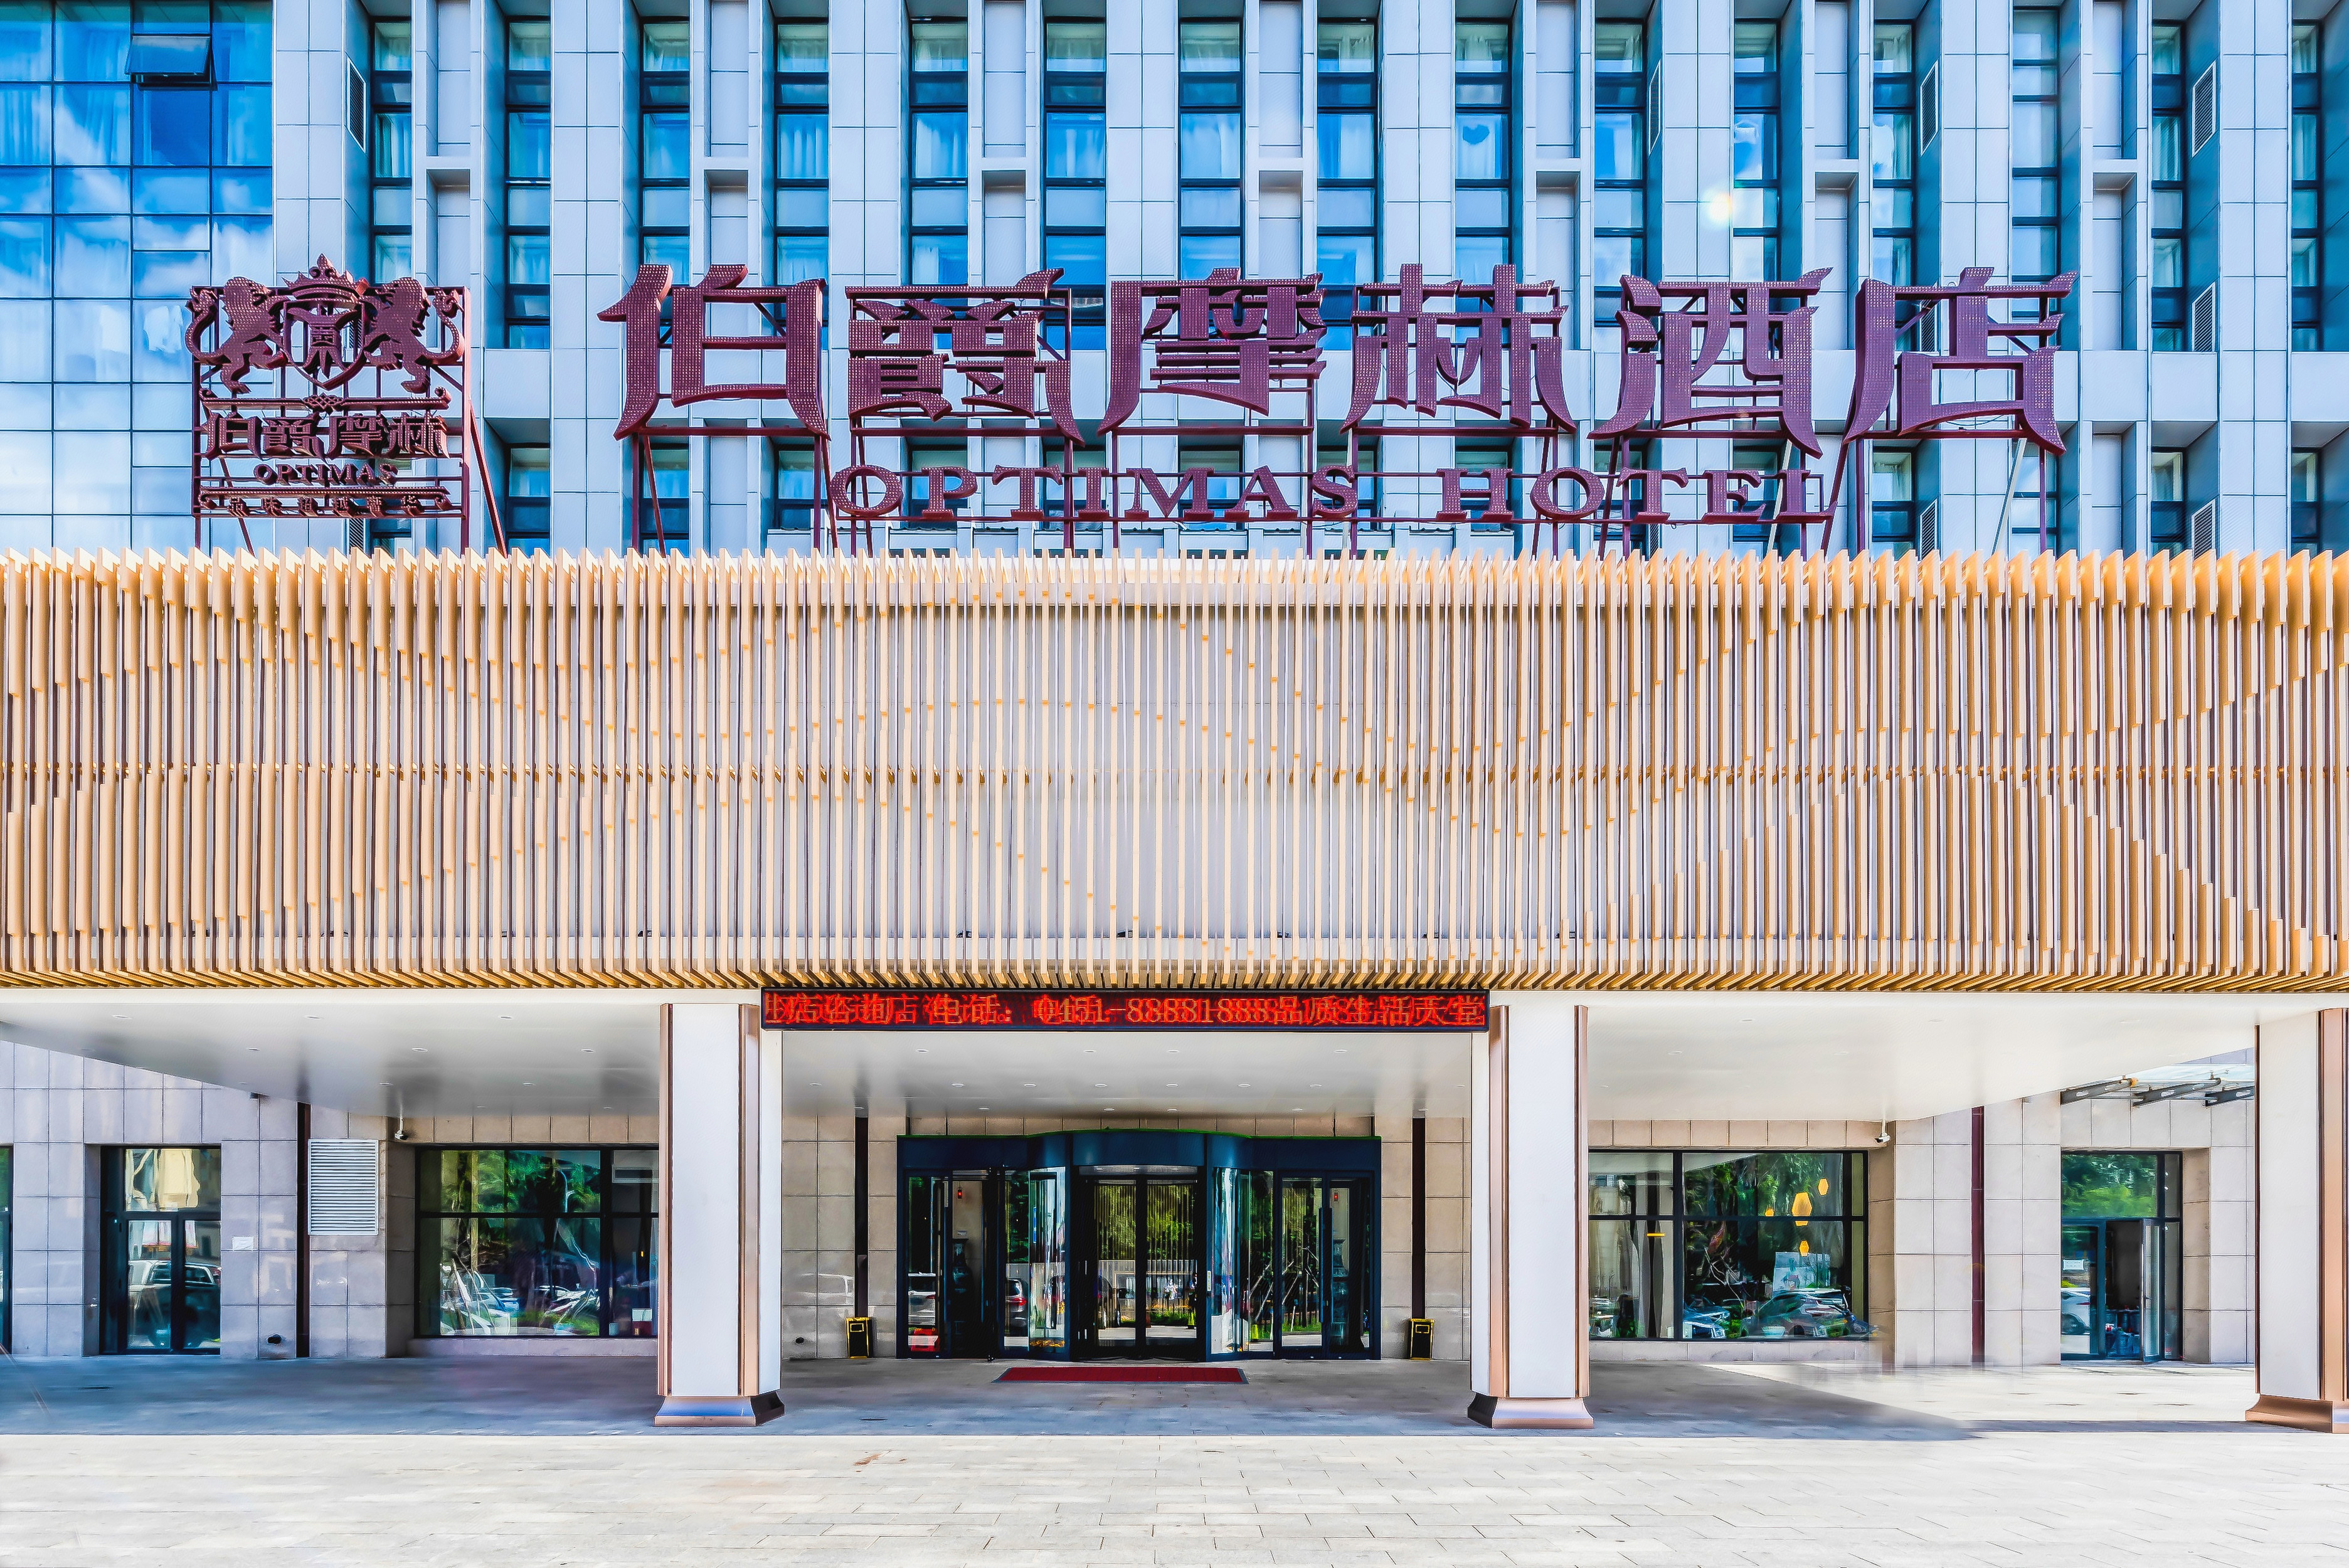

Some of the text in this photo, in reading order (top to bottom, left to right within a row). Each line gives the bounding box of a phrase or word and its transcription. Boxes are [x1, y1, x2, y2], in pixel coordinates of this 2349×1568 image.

[253, 462, 399, 486] OPTIMAS
[829, 464, 1836, 523] OPTIMAS HOTEL
